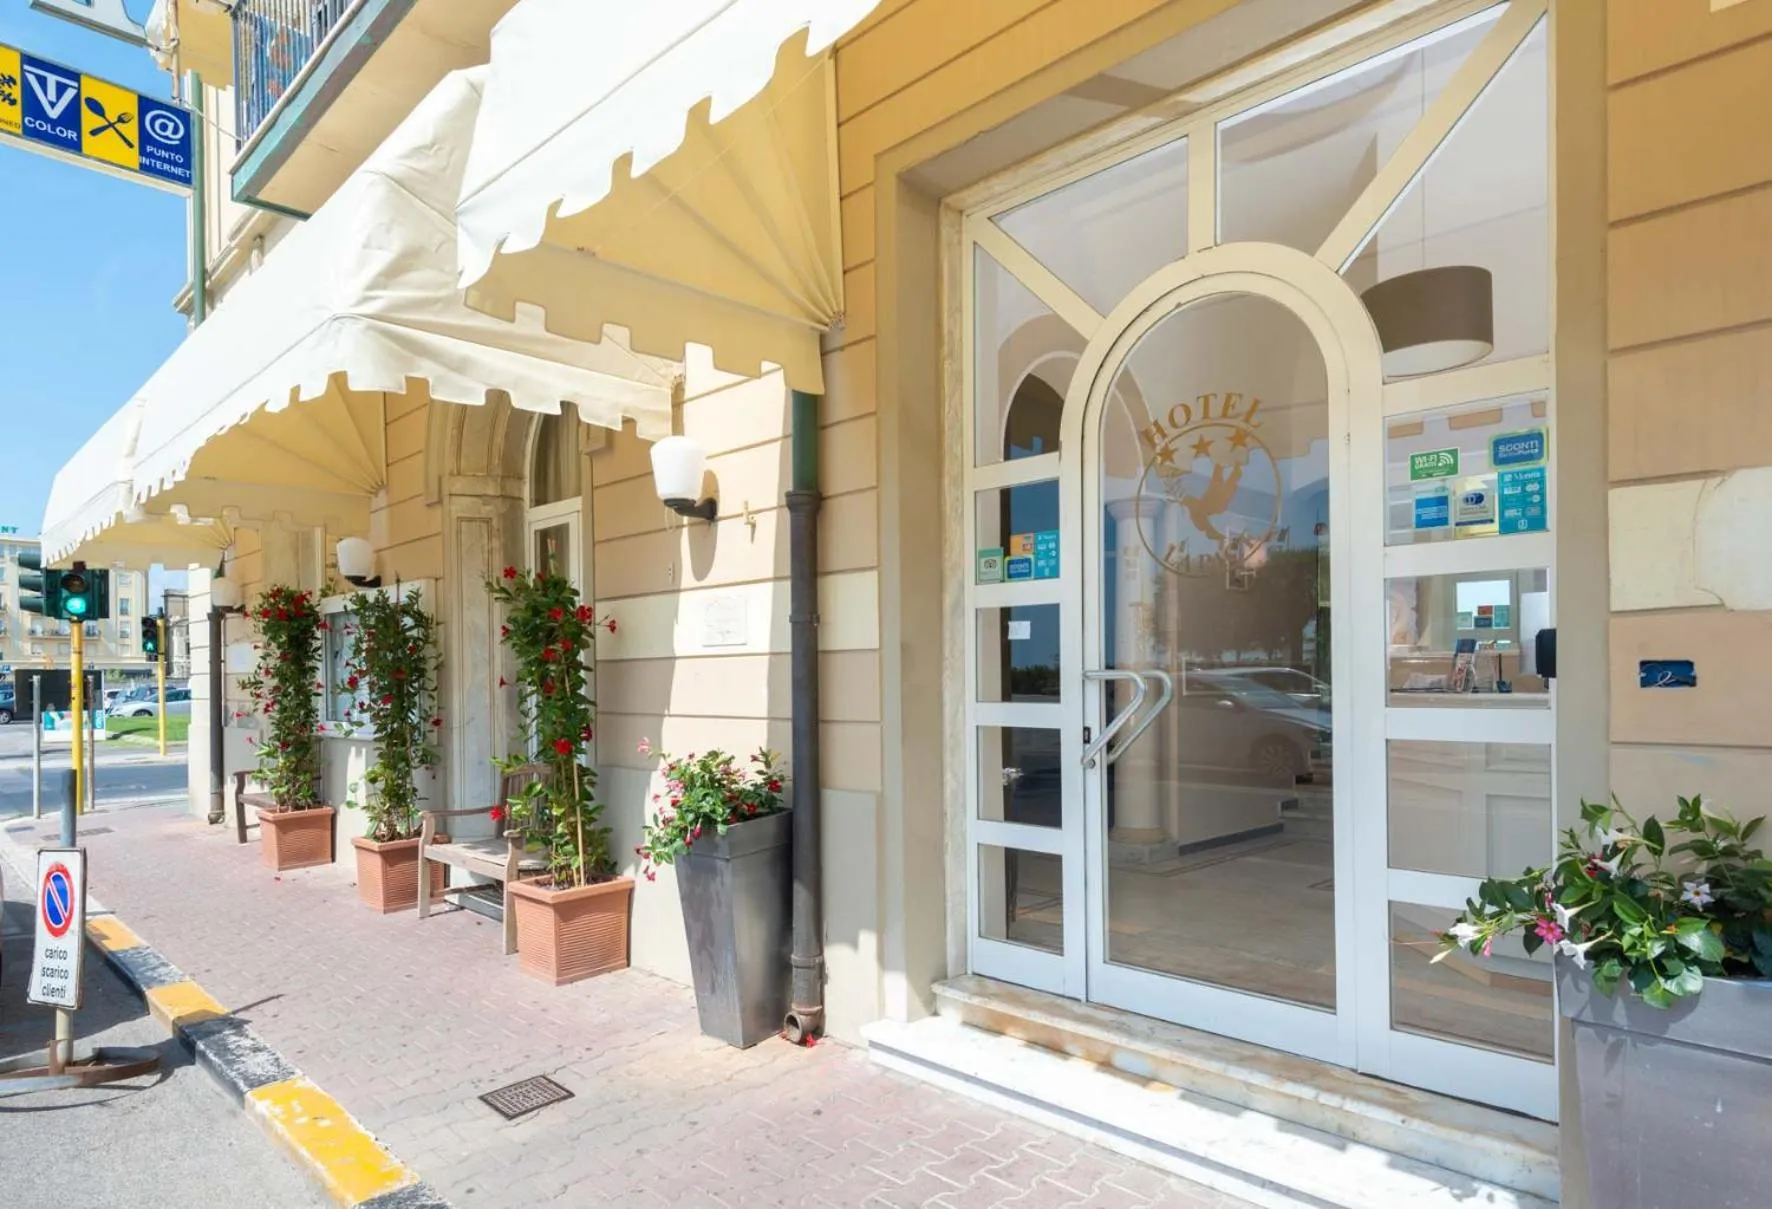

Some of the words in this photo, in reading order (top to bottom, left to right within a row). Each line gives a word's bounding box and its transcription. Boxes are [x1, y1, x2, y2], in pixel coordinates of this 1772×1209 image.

[24, 116, 79, 142] COLOR
[146, 144, 184, 163] PUNTO
[139, 155, 191, 178] INTERNET
[1140, 391, 1263, 451] HOTEL
[44, 946, 68, 961] carico
[41, 965, 70, 980] scarico
[41, 984, 66, 999] clienti
